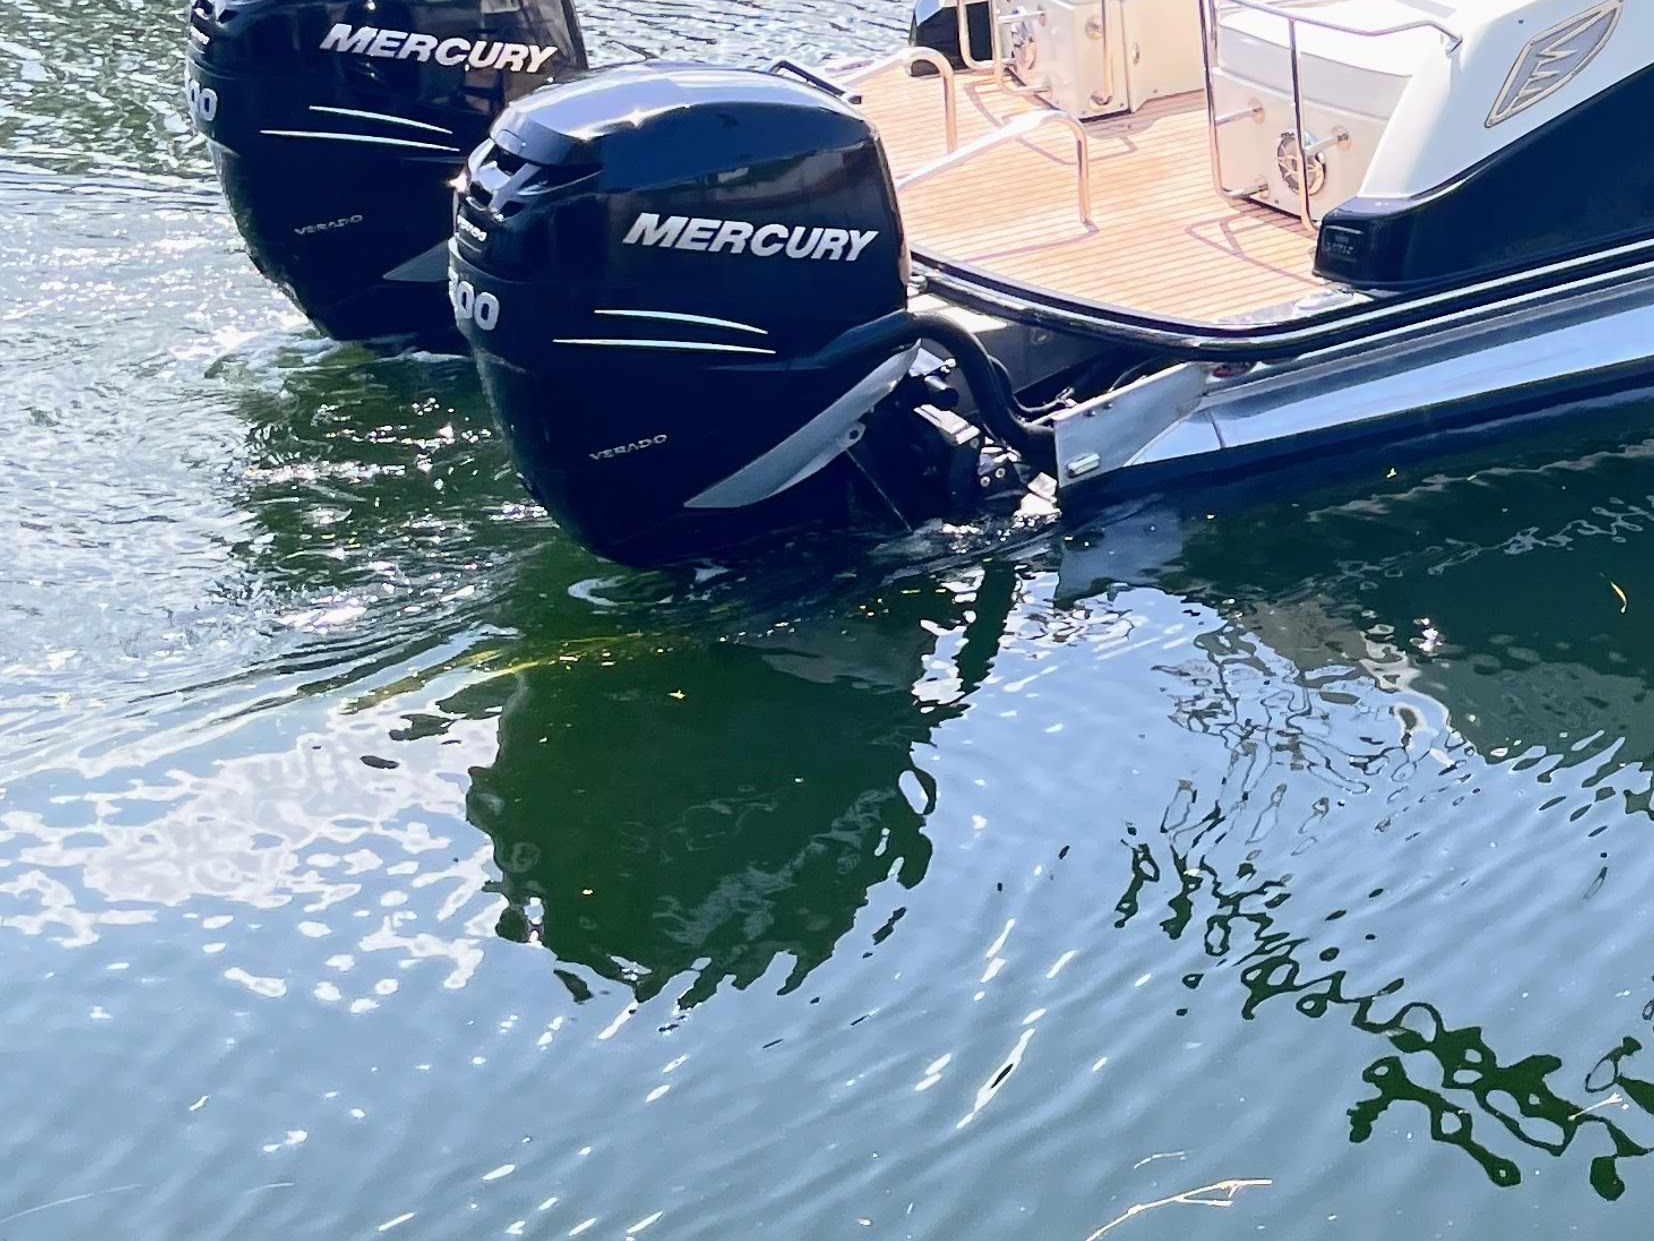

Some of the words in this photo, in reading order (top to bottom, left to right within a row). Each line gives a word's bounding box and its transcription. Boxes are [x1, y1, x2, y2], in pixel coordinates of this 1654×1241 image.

[318, 22, 558, 73] MERCURY
[621, 211, 880, 262] MERCURY
[588, 433, 668, 461] VERADO
